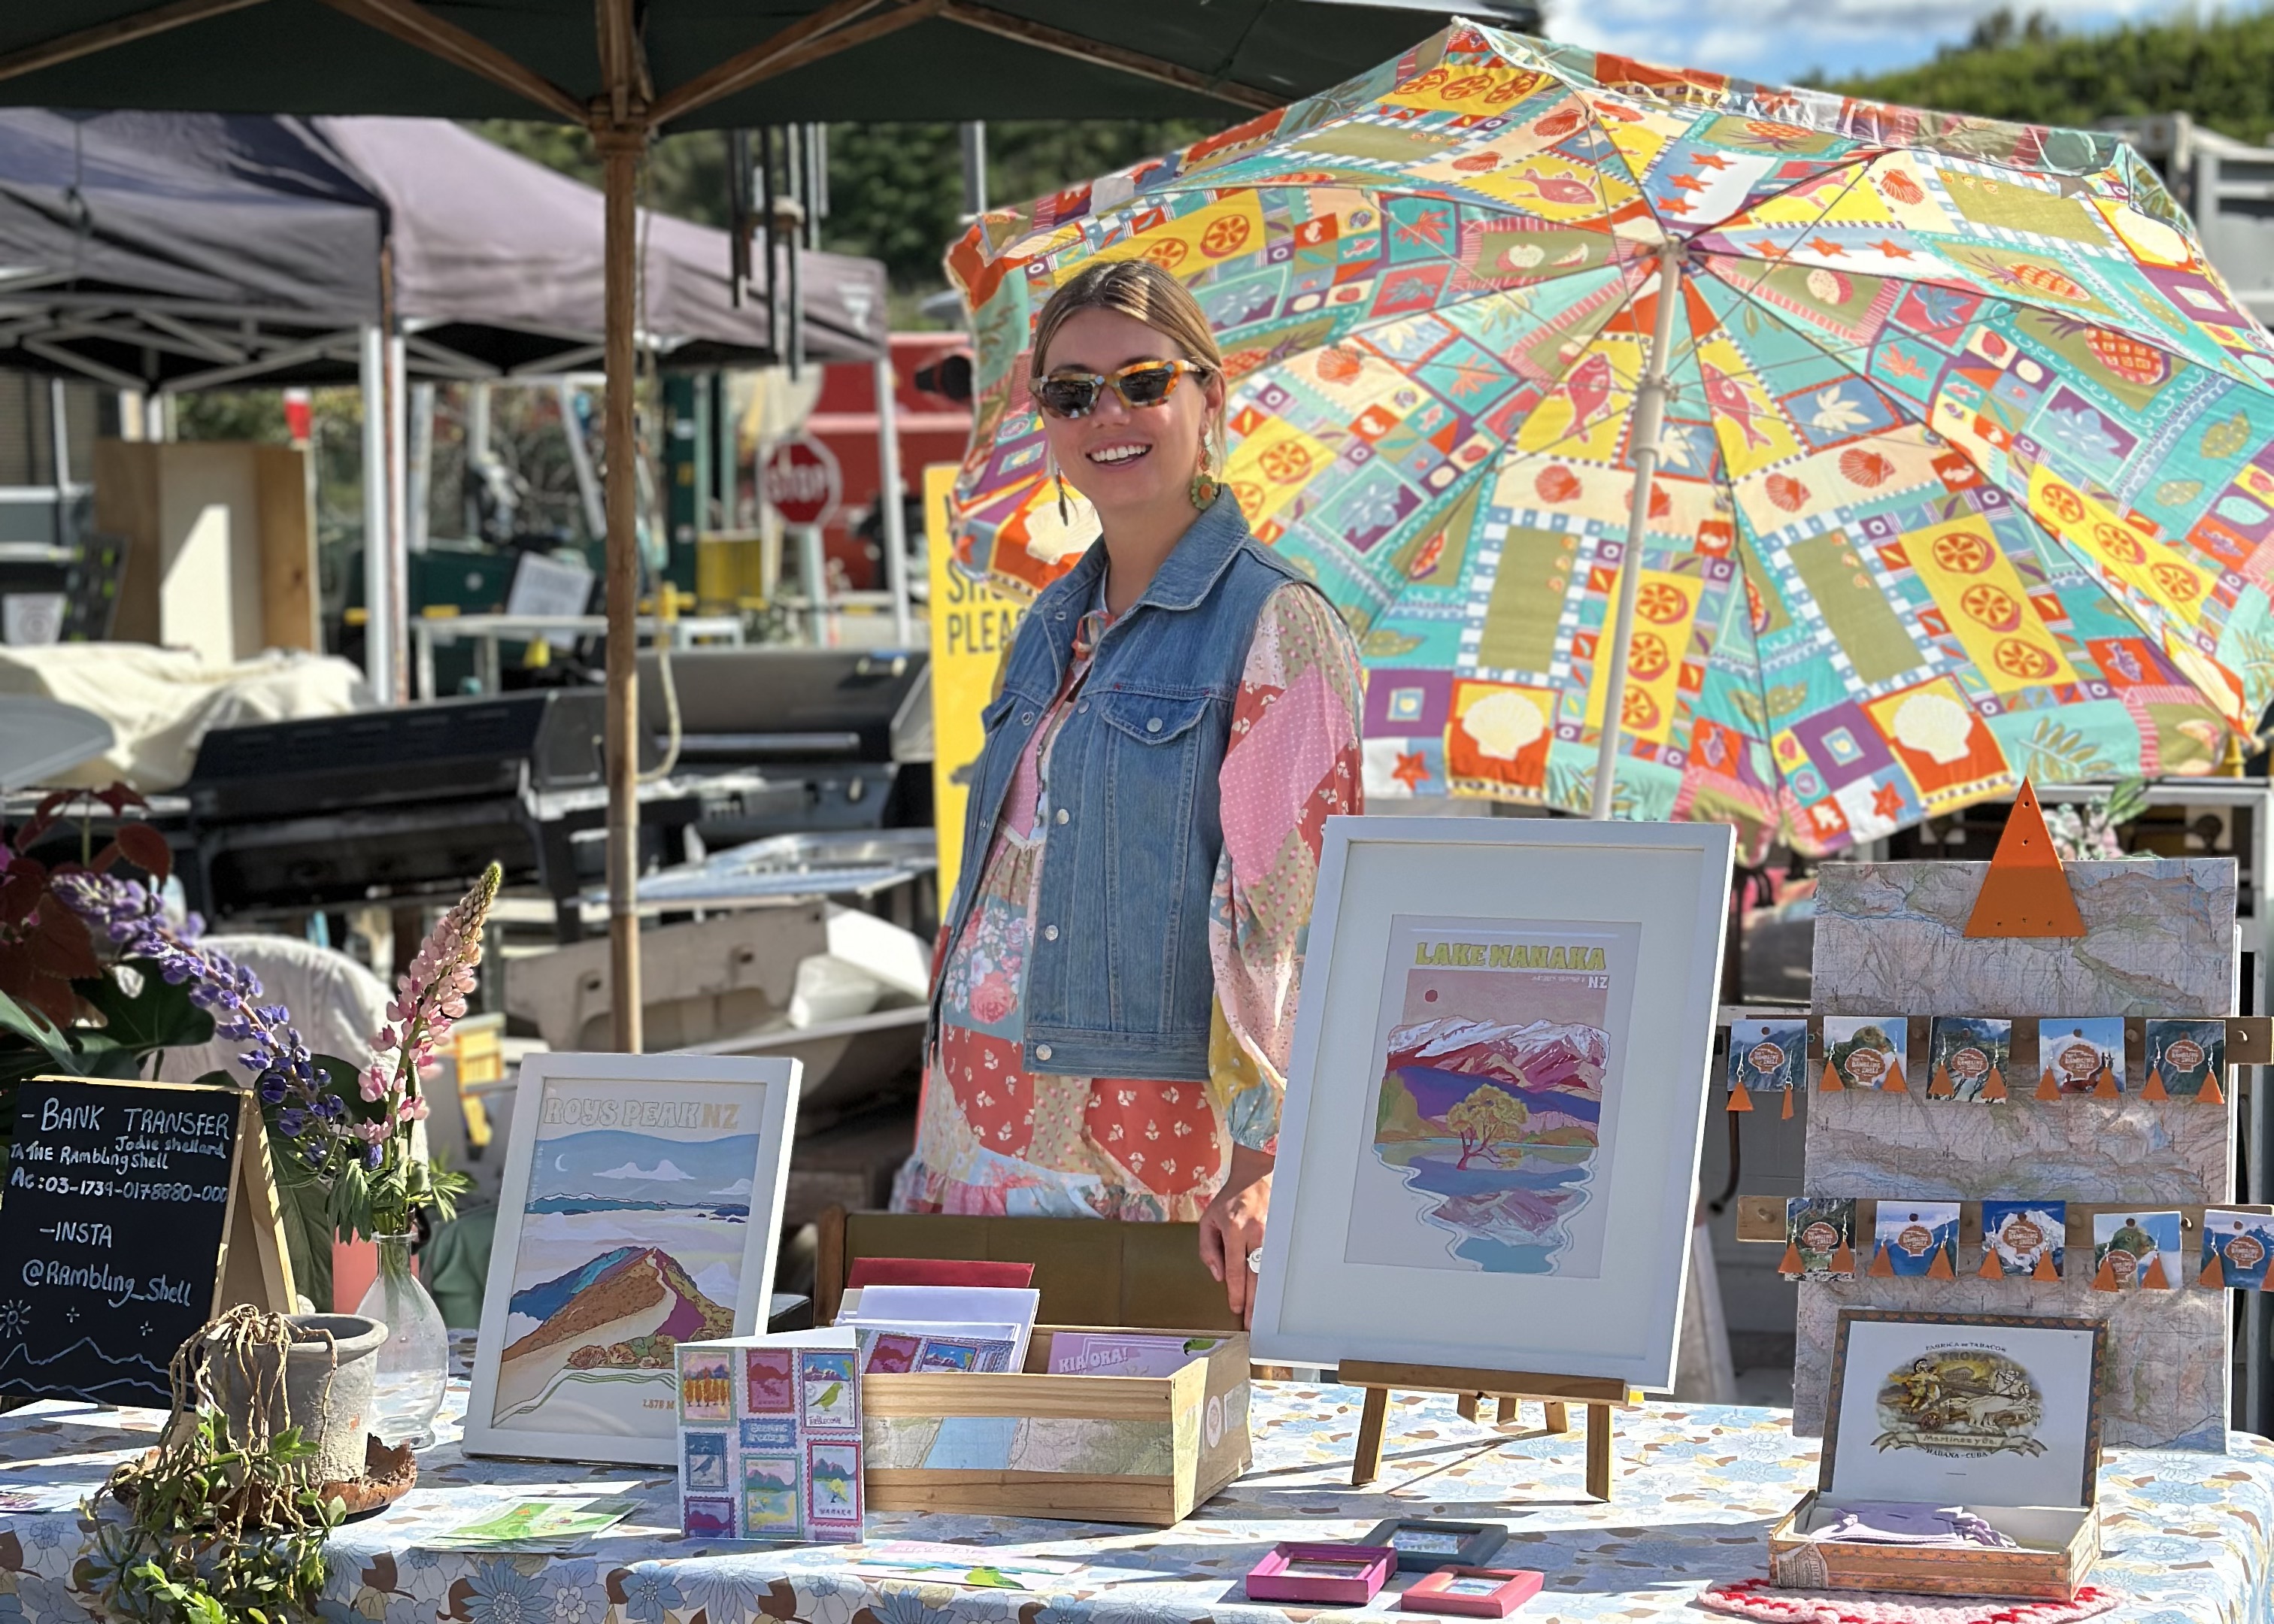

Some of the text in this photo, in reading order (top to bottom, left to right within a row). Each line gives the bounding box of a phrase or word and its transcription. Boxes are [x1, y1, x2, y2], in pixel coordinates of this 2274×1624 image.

[1415, 942, 1487, 967] LAKE
[1587, 975, 1608, 989] NZ
[123, 1107, 229, 1140] TRANSFER
[543, 1098, 741, 1129] ROYS PEAK NZ
[1059, 1347, 1129, 1374] KIA ORA!
